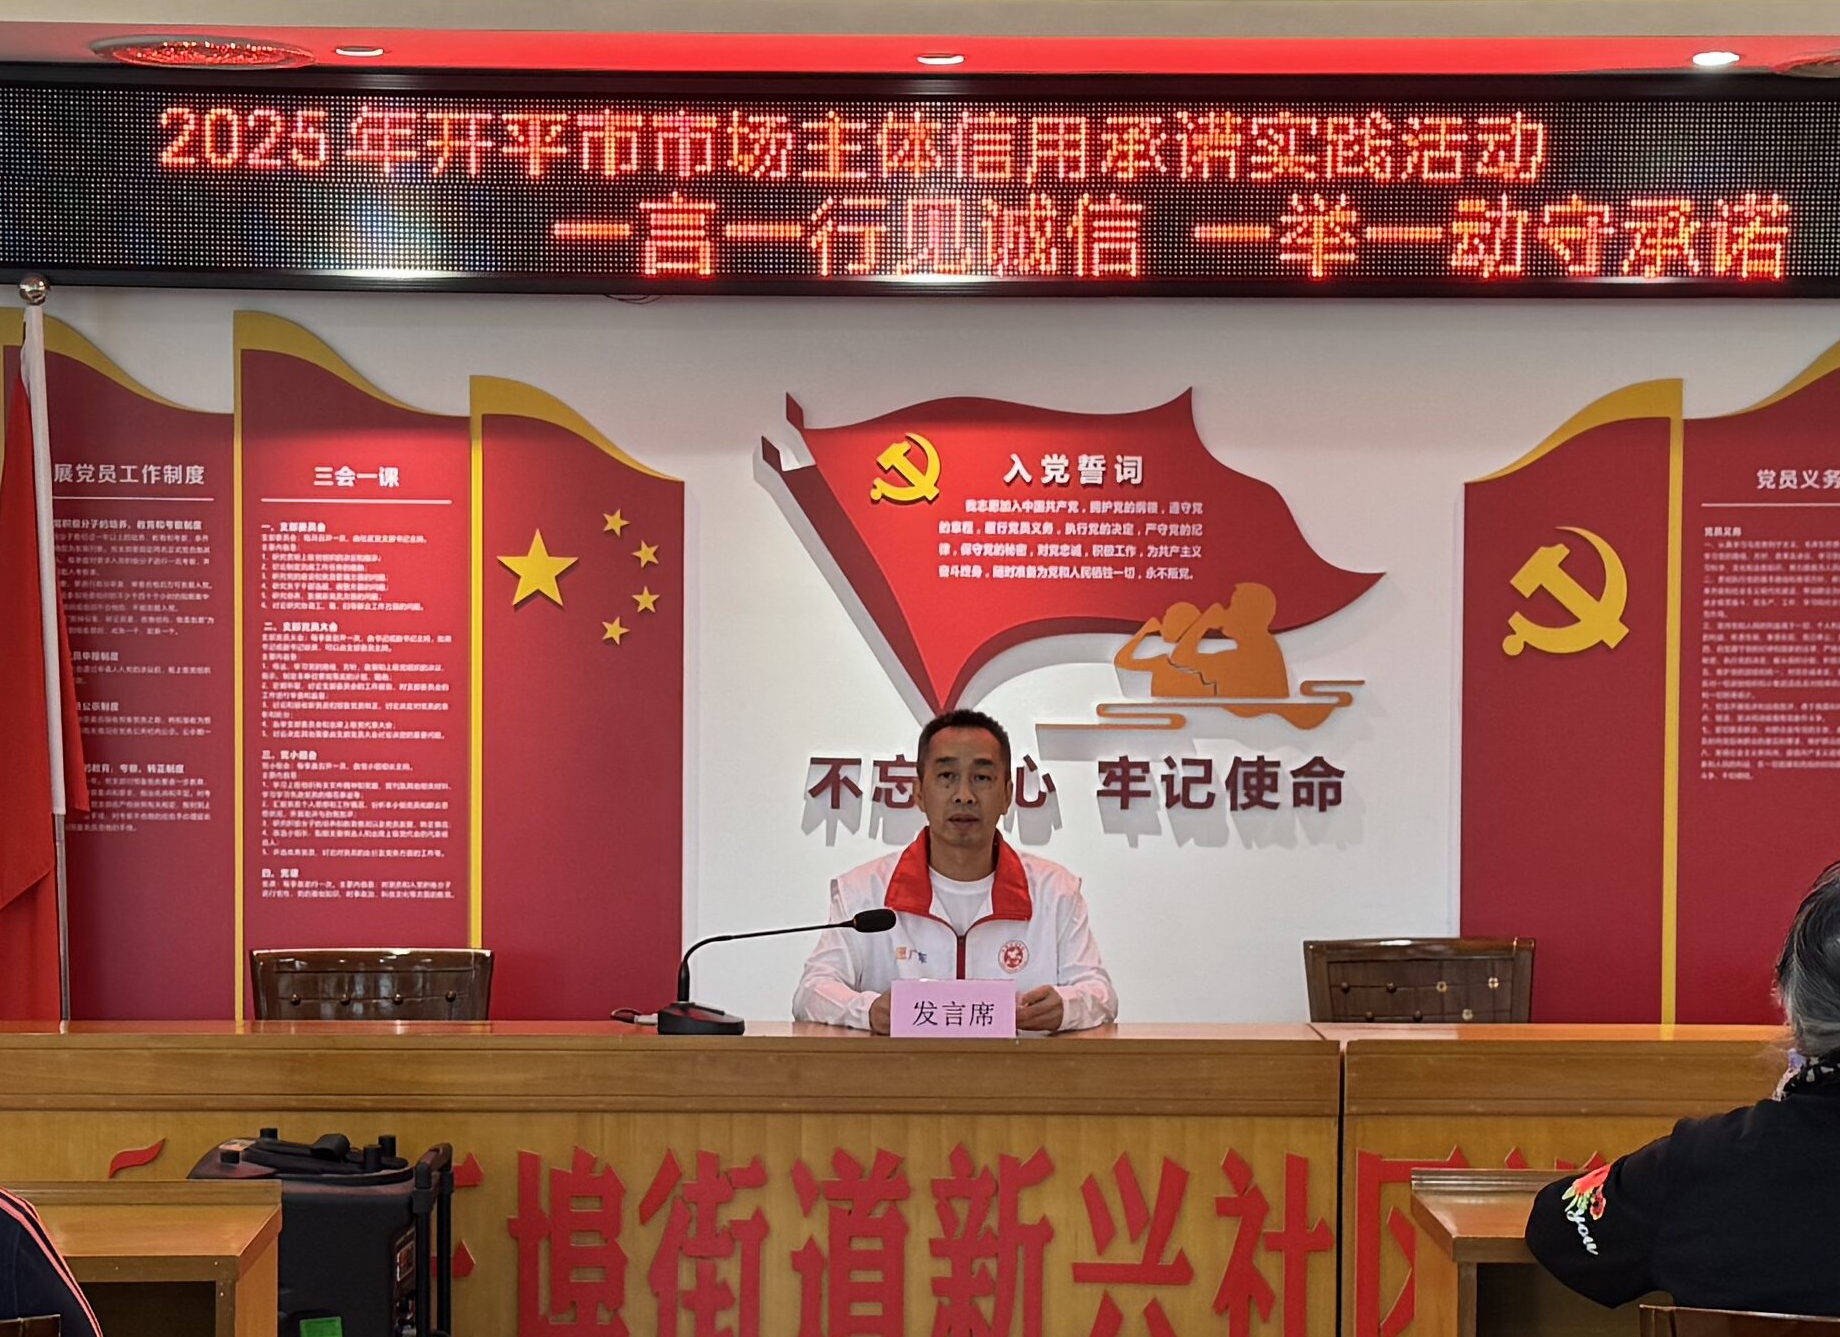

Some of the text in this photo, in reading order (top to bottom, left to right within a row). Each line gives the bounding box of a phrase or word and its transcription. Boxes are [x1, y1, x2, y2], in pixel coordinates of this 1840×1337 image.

[555, 191, 1792, 281] 一言一行见诚信 一举一动守承诺
[53, 463, 206, 485] 展党员工作制度
[312, 465, 401, 489] 三会一课
[1002, 452, 1144, 486] 入党誓词
[810, 755, 1346, 812] 不忘心 牢记使命
[911, 1000, 996, 1028] 发言席
